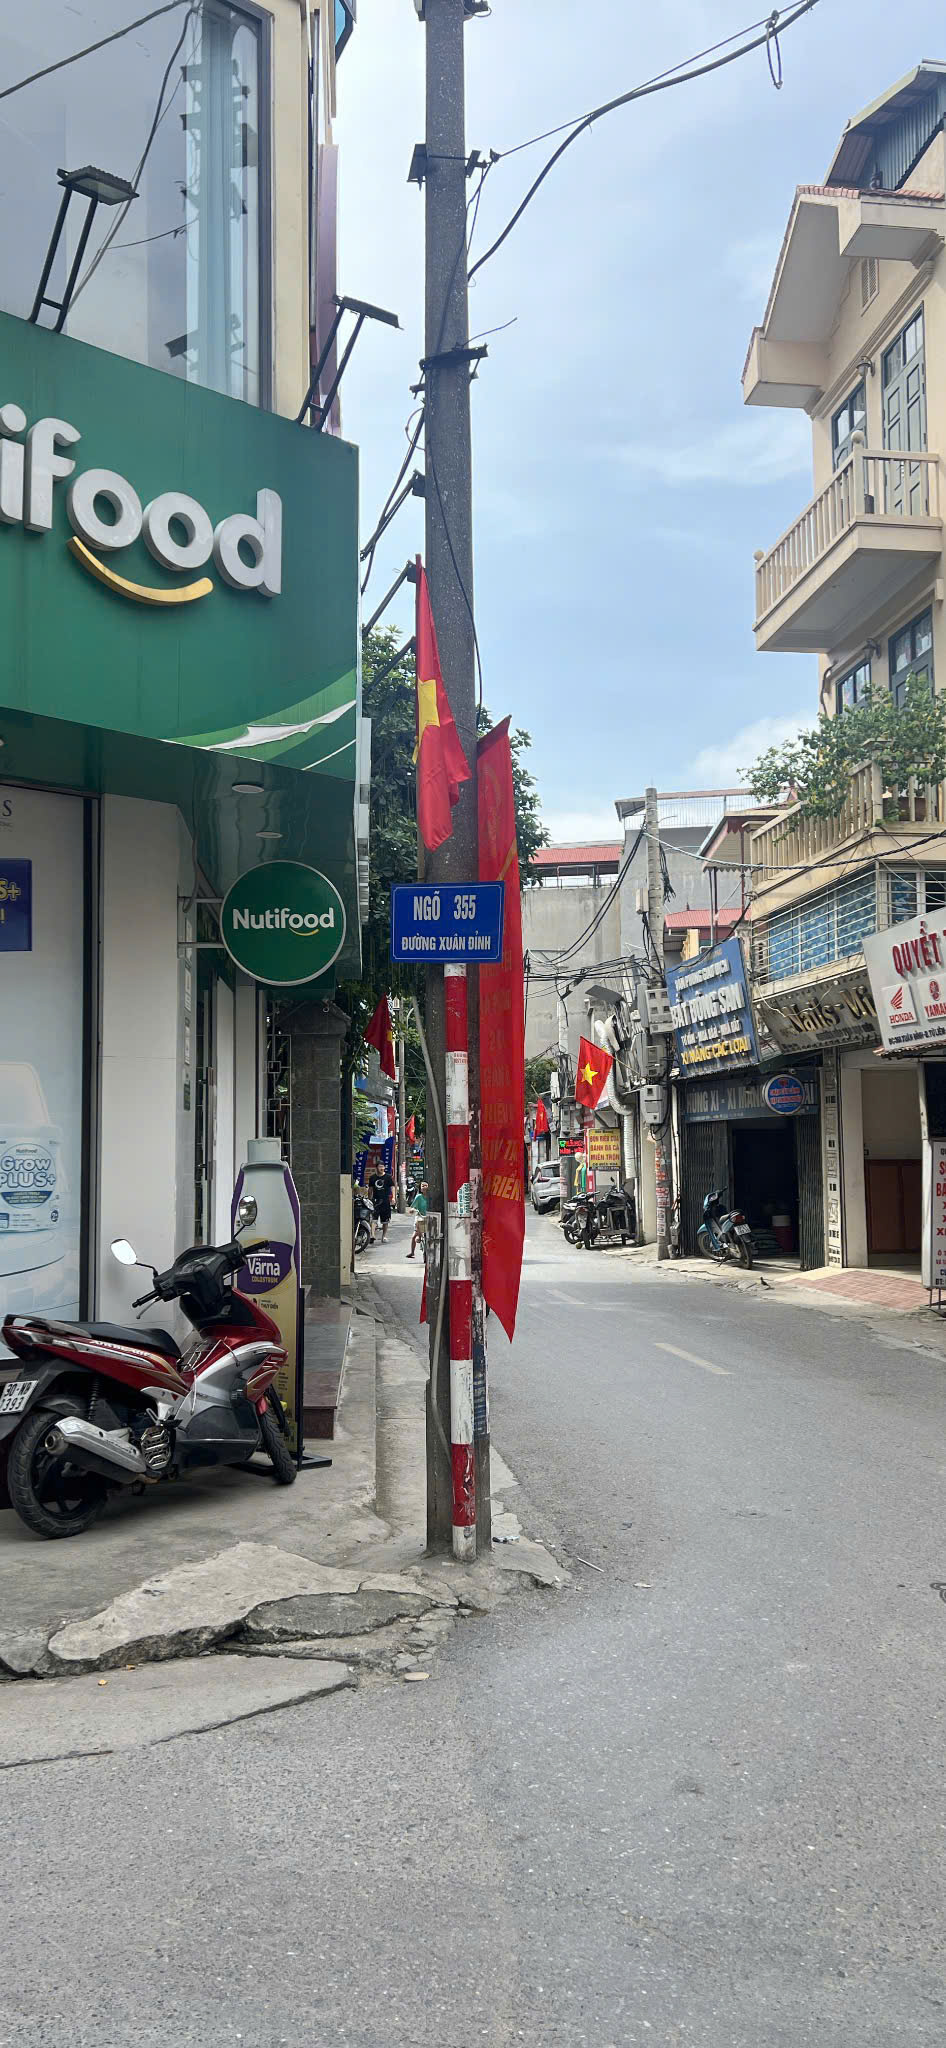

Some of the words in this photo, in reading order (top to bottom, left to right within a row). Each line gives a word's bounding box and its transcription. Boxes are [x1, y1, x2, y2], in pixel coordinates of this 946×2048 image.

[413, 891, 441, 921] NGÕ
[453, 895, 477, 919] 355
[232, 907, 335, 930] Nutifood
[401, 932, 436, 951] ĐƯỜNG
[439, 933, 466, 951] XUÂN
[467, 930, 491, 950] ĐỈNH
[892, 920, 942, 976] QUYẾT
[889, 1011, 914, 1024] HONDA
[1, 1155, 52, 1172] Grow
[247, 1257, 280, 1276] Värna
